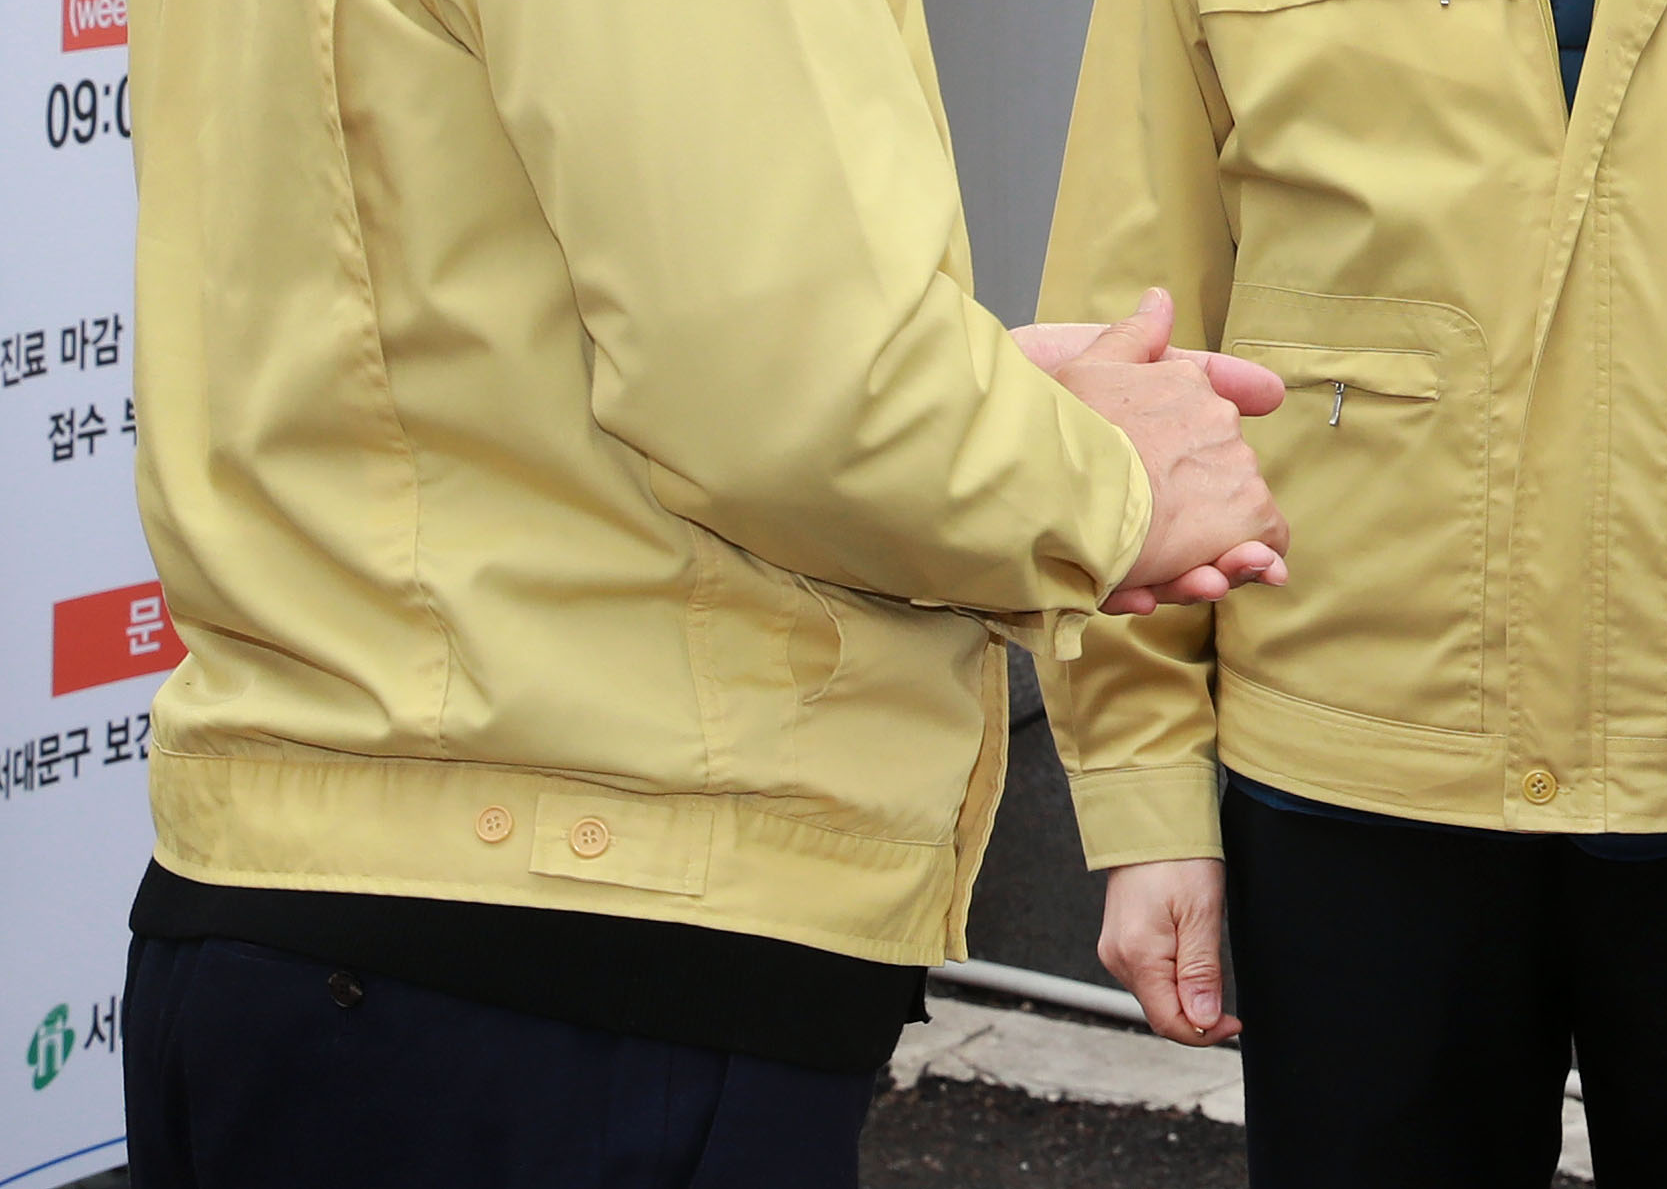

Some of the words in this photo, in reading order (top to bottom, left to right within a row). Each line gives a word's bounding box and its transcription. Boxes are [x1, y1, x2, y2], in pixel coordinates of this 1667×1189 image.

[0, 330, 48, 388] 진료
[60, 312, 123, 371] 마감
[48, 403, 108, 463] 접수
[126, 595, 165, 656] 문
